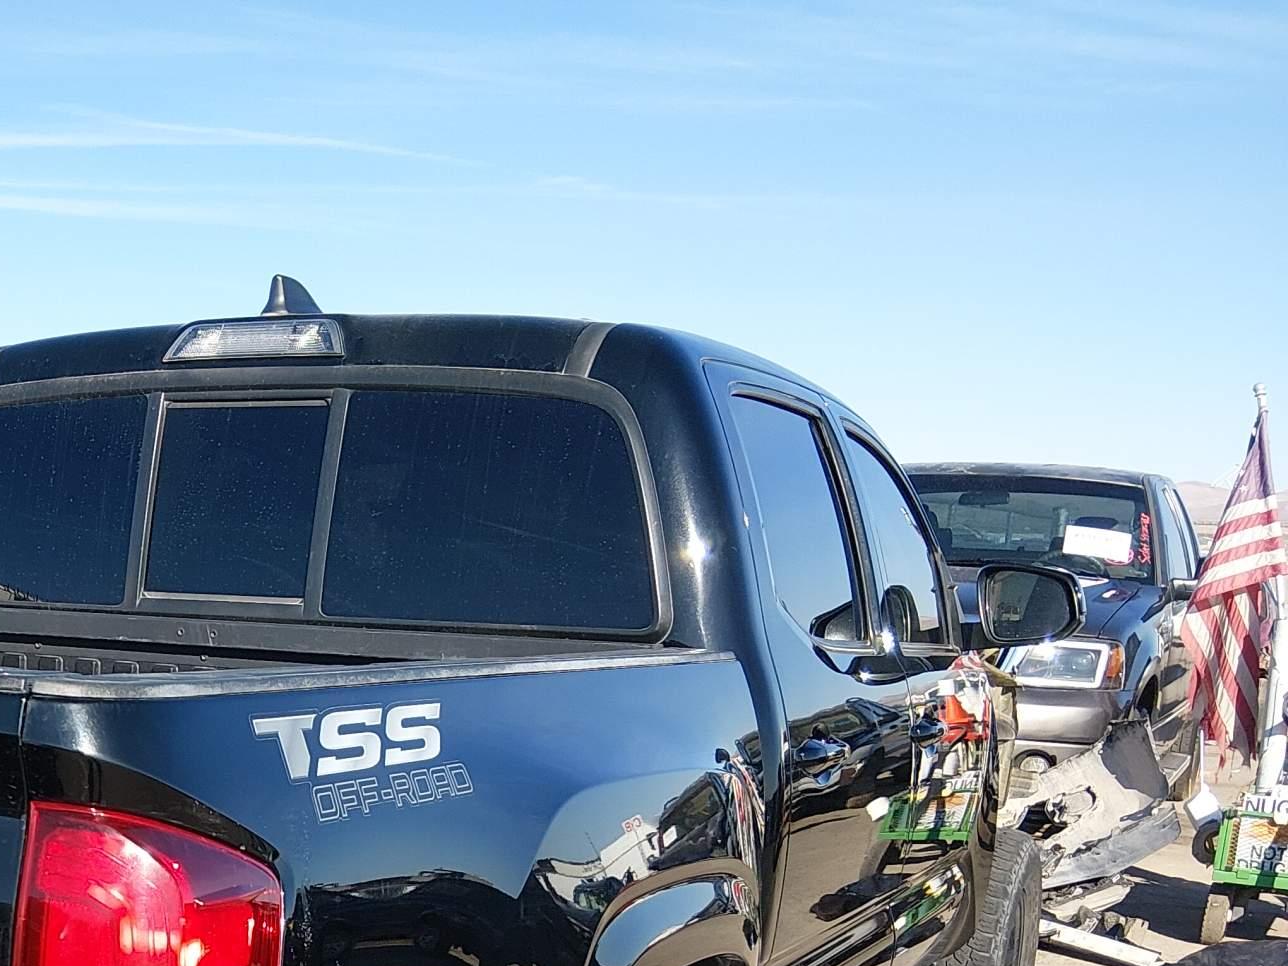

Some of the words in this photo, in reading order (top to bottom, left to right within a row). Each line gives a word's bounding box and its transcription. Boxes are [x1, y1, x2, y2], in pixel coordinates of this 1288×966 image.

[252, 702, 442, 780] TSS
[312, 762, 474, 823] OFF-ROAD
[1251, 845, 1288, 862] NOT
